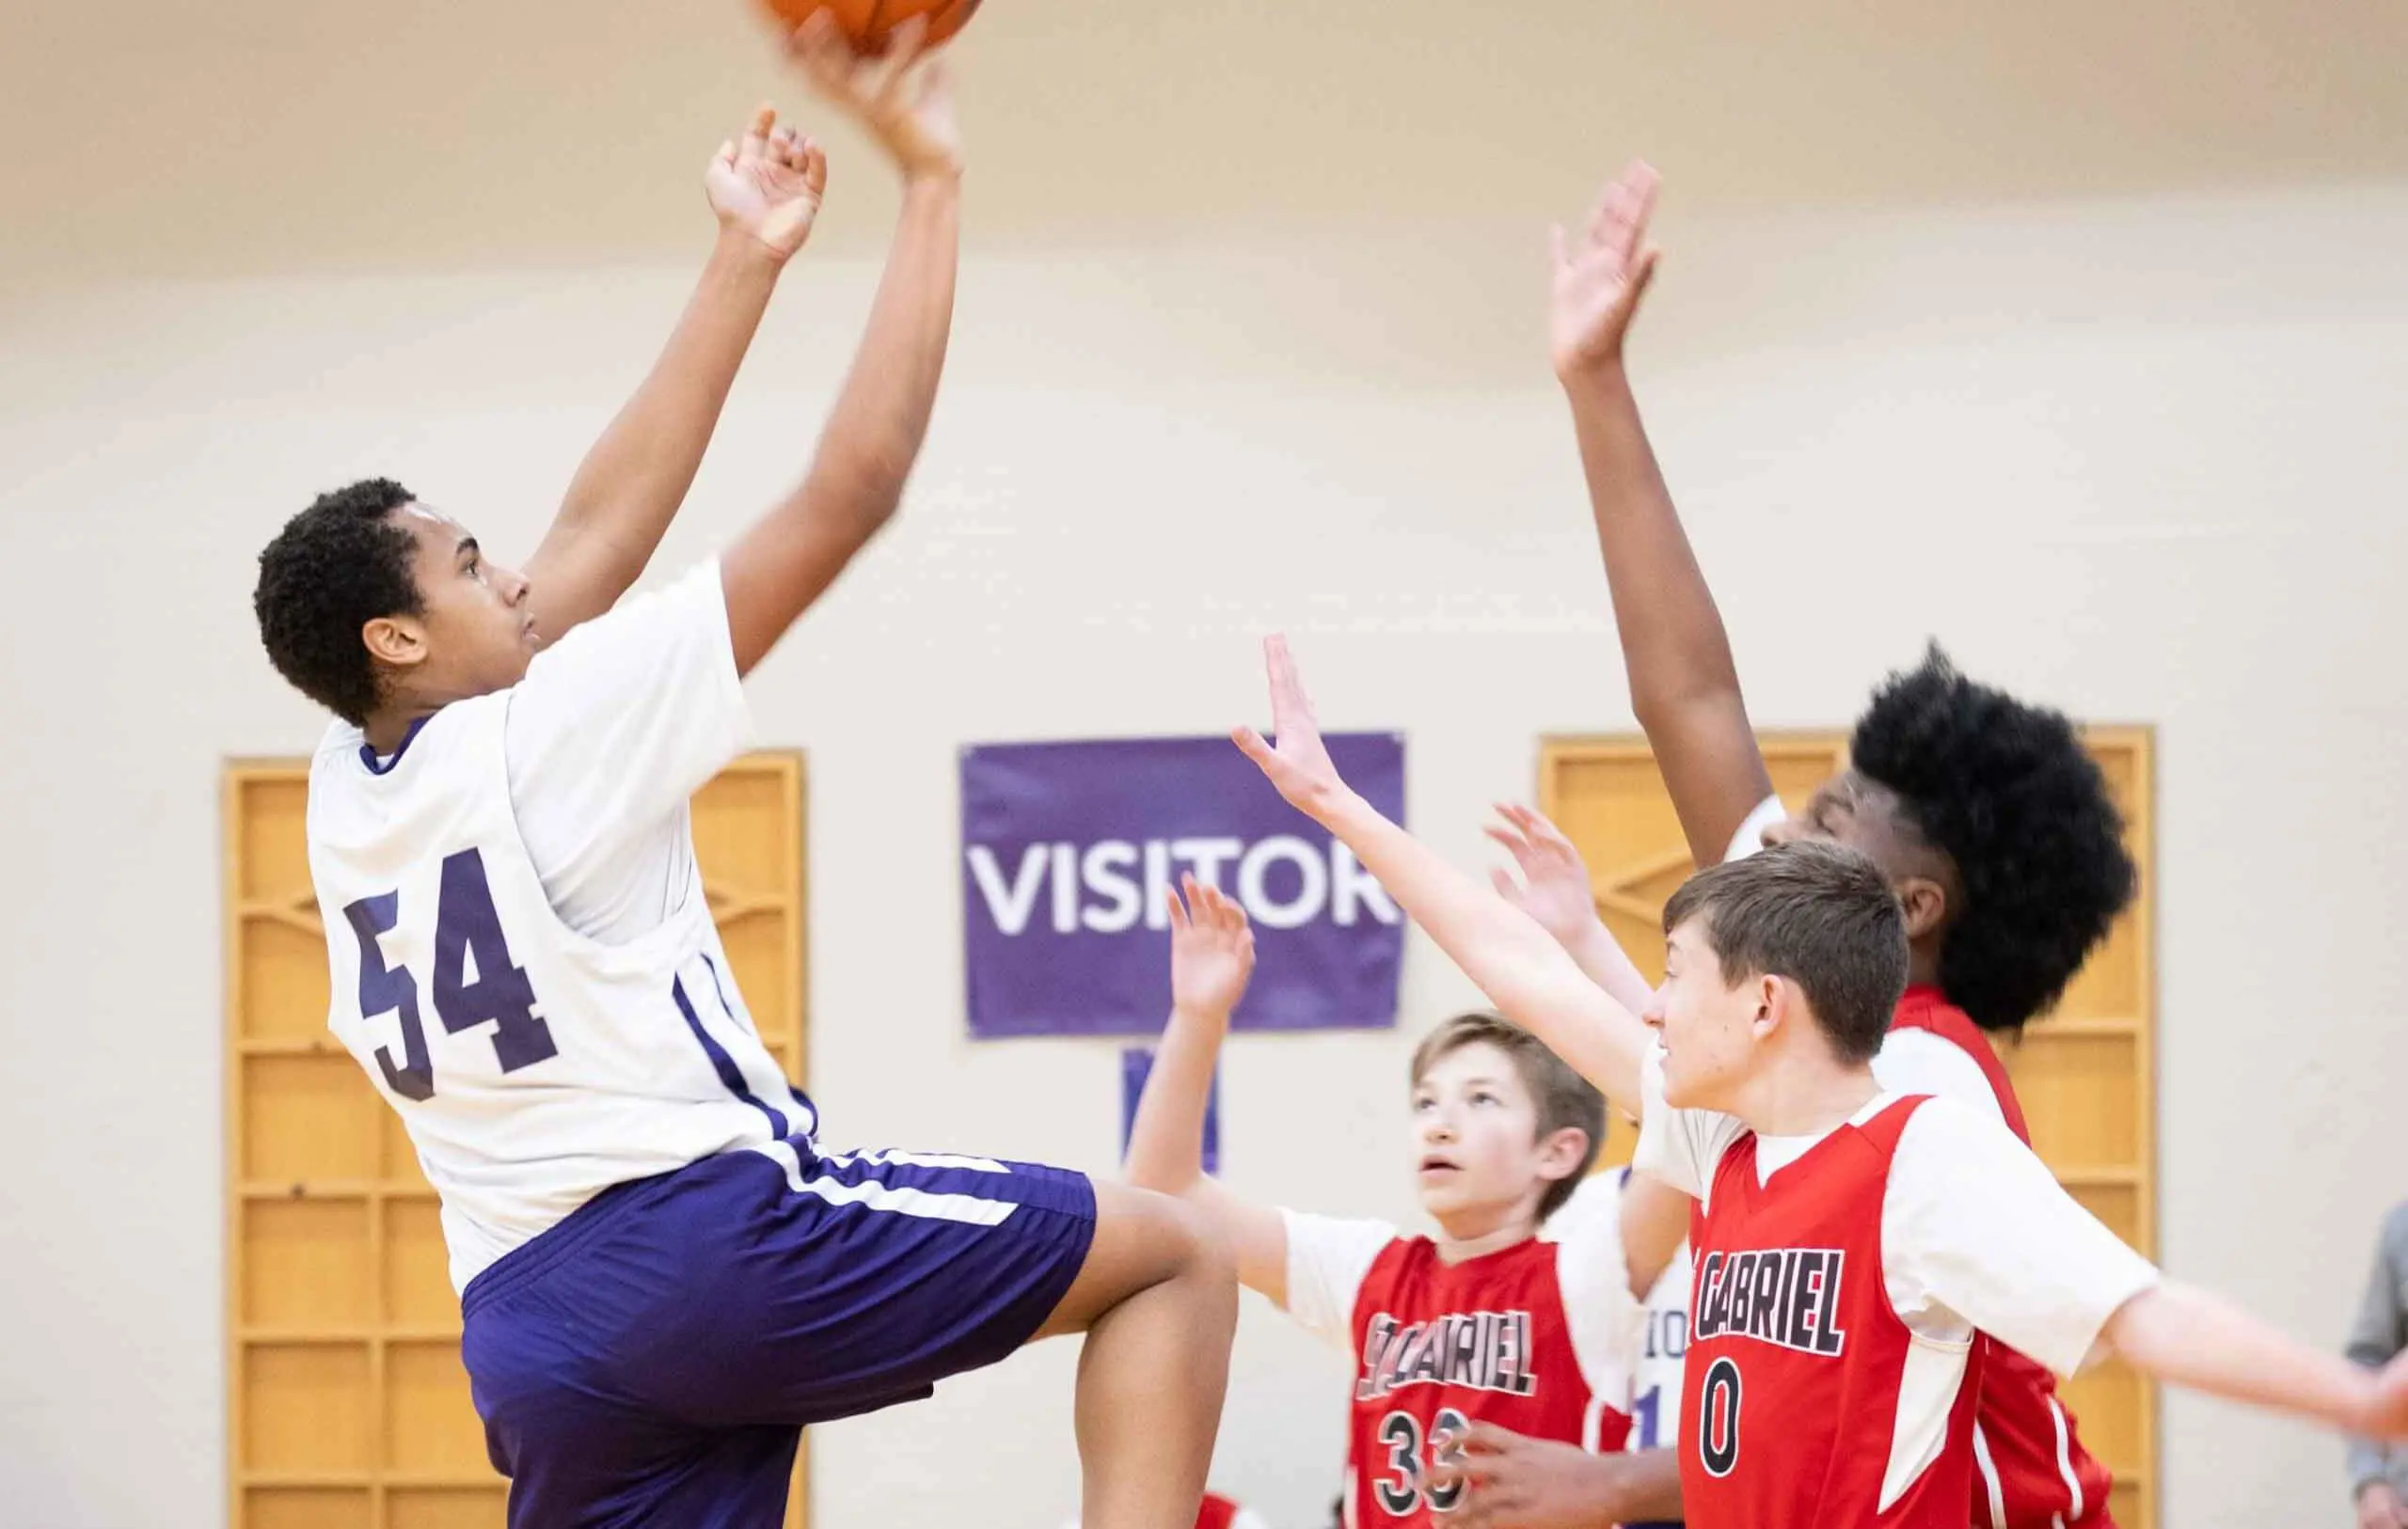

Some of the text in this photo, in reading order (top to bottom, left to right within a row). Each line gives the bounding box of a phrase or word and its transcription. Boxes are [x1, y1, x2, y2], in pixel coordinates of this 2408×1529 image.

[343, 846, 558, 1102] 54
[1696, 1249, 1845, 1357] GABRIEL
[1373, 1408, 1471, 1517] 33
[1700, 1357, 1742, 1477] 0
